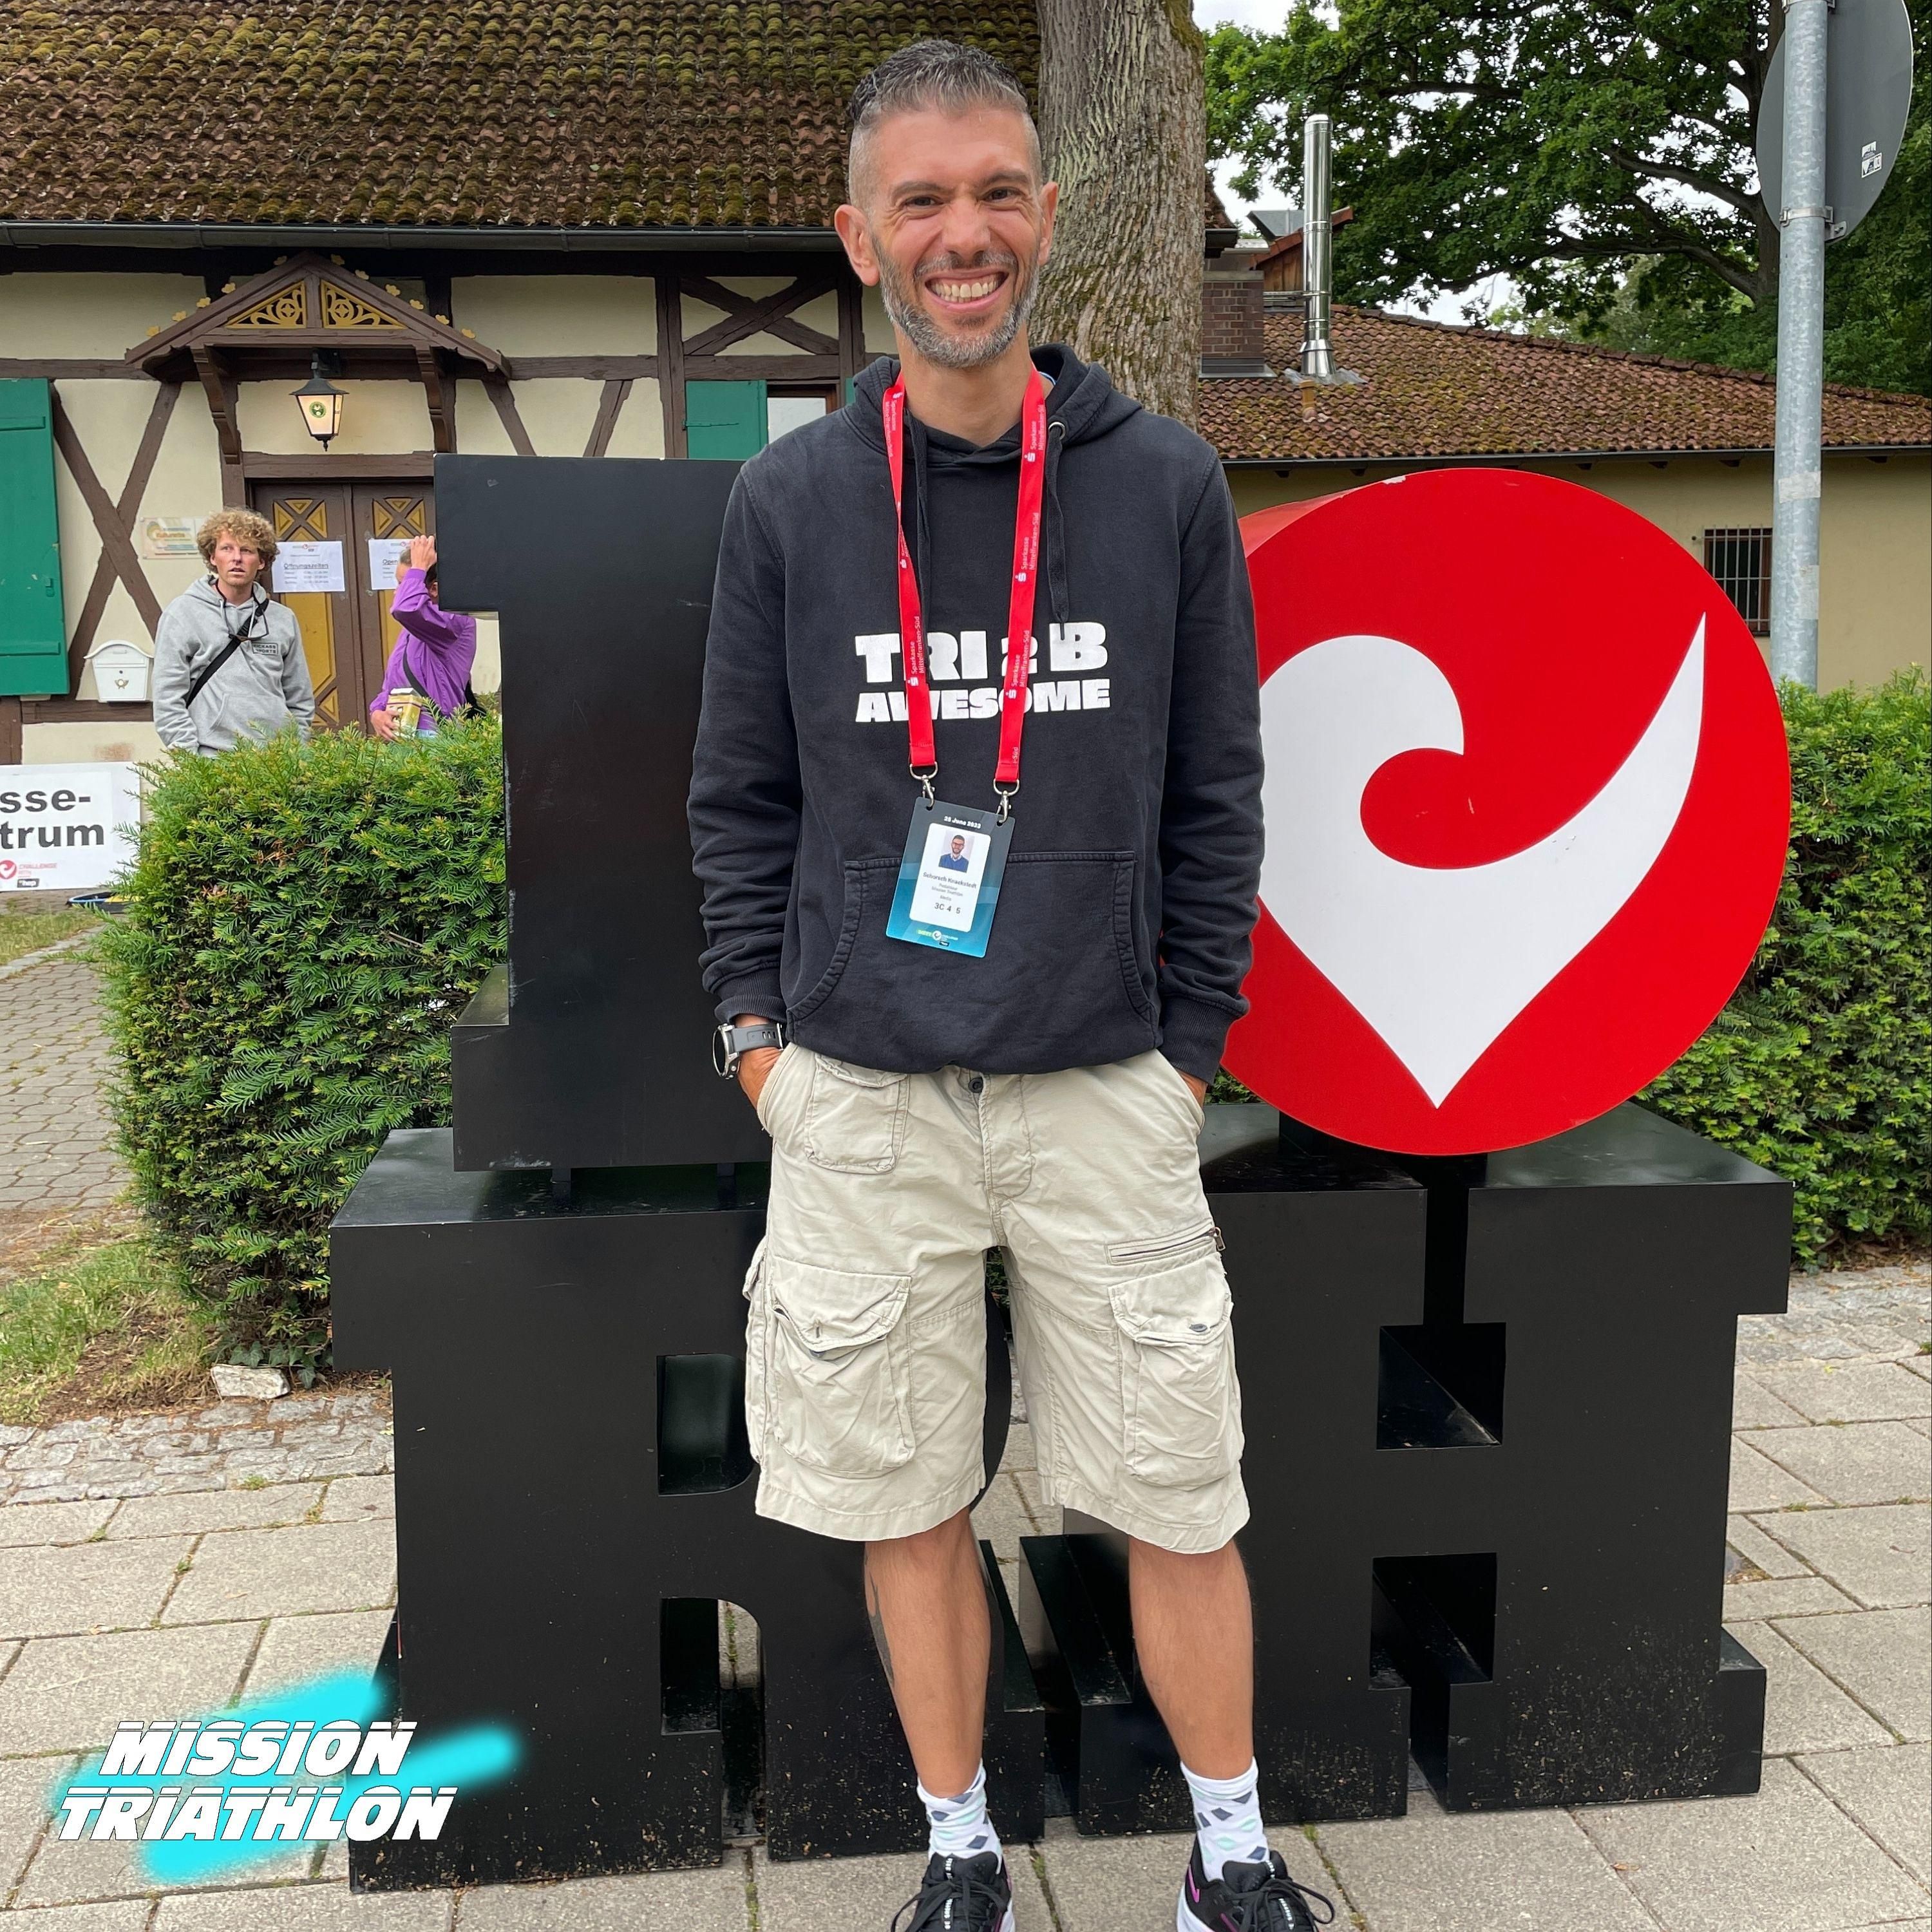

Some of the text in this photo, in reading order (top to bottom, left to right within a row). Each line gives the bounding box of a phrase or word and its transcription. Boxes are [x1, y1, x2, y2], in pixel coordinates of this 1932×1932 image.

[1021, 536, 1029, 570] Sparkasse
[1048, 621, 1108, 672] B
[1011, 654, 1021, 687] Sparkasse
[0, 790, 91, 813] sse-
[0, 821, 104, 849] trum
[952, 817, 967, 826] June
[934, 902, 945, 911] 3C
